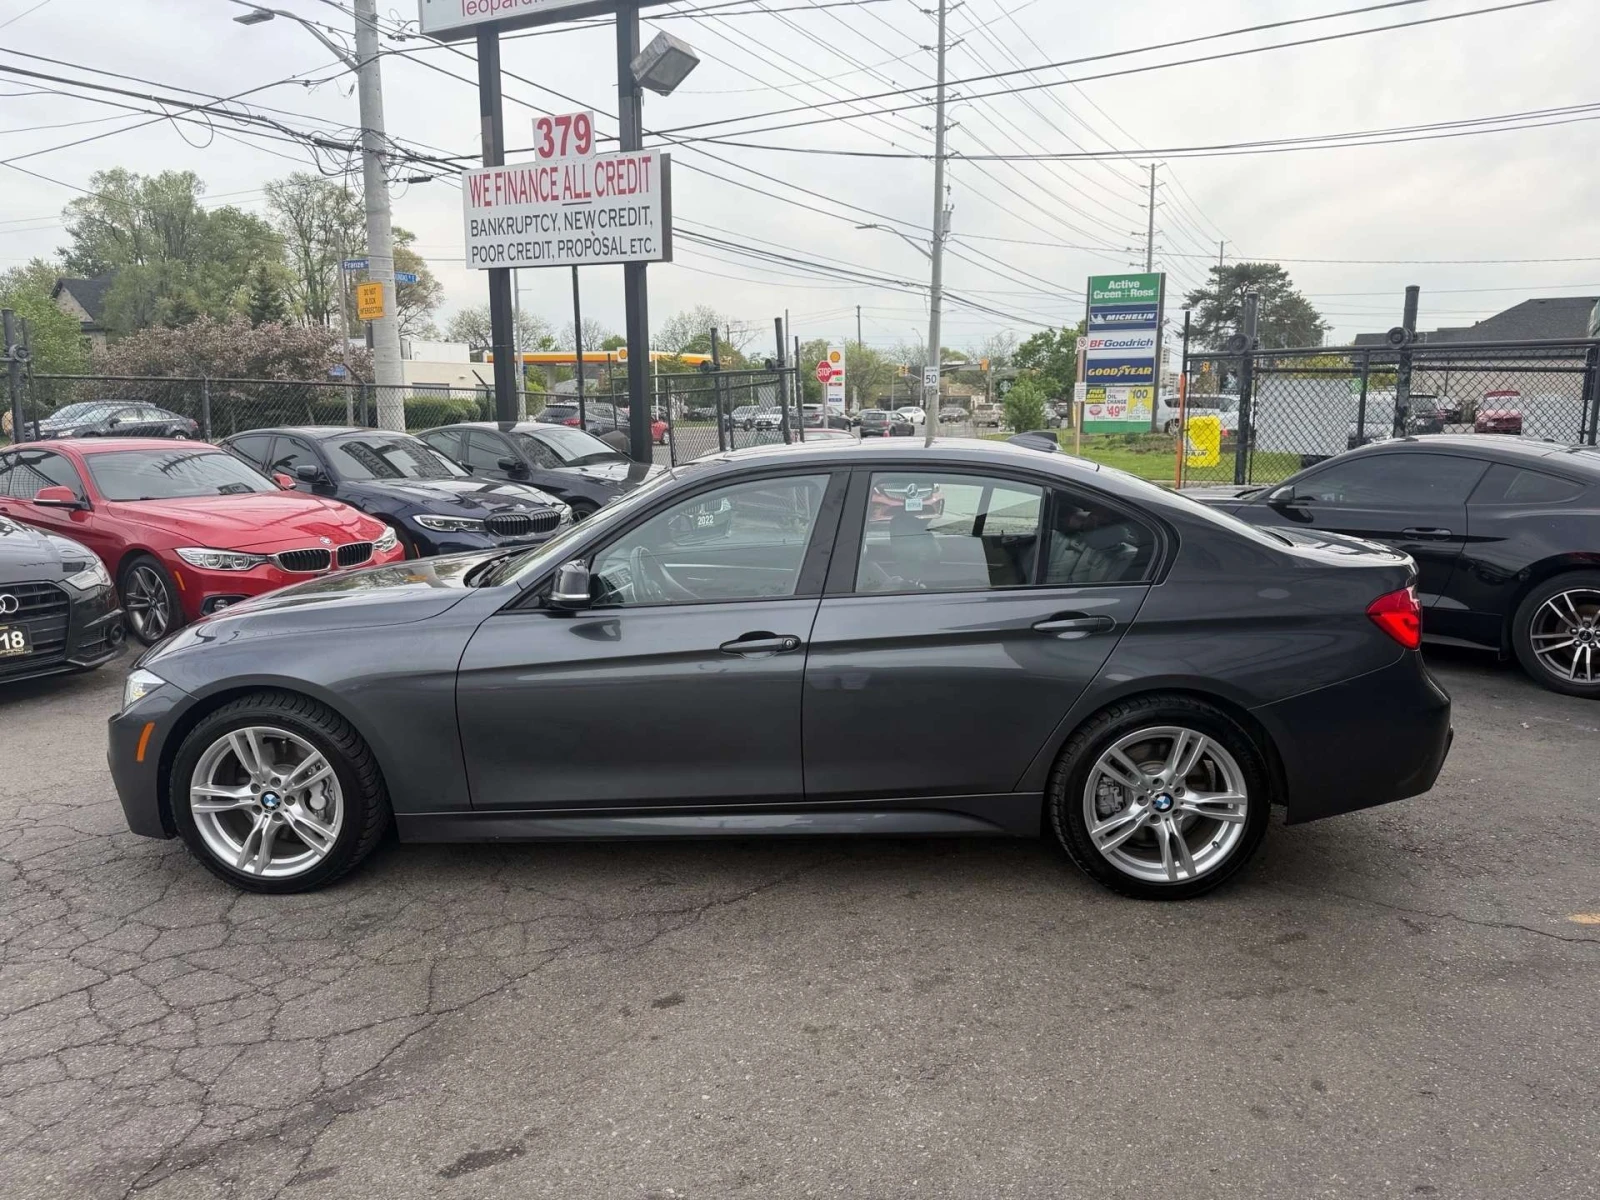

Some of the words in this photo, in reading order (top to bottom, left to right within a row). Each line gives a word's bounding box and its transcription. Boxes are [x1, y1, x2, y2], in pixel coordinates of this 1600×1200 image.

[536, 113, 592, 159] 379
[468, 173, 492, 208] WE
[494, 166, 559, 207] FINANCE
[562, 163, 591, 200] ALL
[594, 156, 652, 197] CREDIT
[470, 212, 560, 237] BANKRUPTCY,
[564, 209, 597, 230] NEW
[597, 205, 653, 228] CREDIT,
[472, 243, 505, 263] POOR
[507, 240, 555, 262] CREDIT,
[557, 235, 628, 258] PROPOSAL
[630, 237, 657, 255] ETC.
[1108, 280, 1140, 290] Active
[1105, 313, 1155, 321] MICHELIN
[1089, 338, 1154, 348] BFGoodrich
[817, 367, 832, 377] STOP
[1088, 365, 1152, 377] GOODYEAR
[925, 374, 937, 384] 50
[697, 514, 714, 525] 2022
